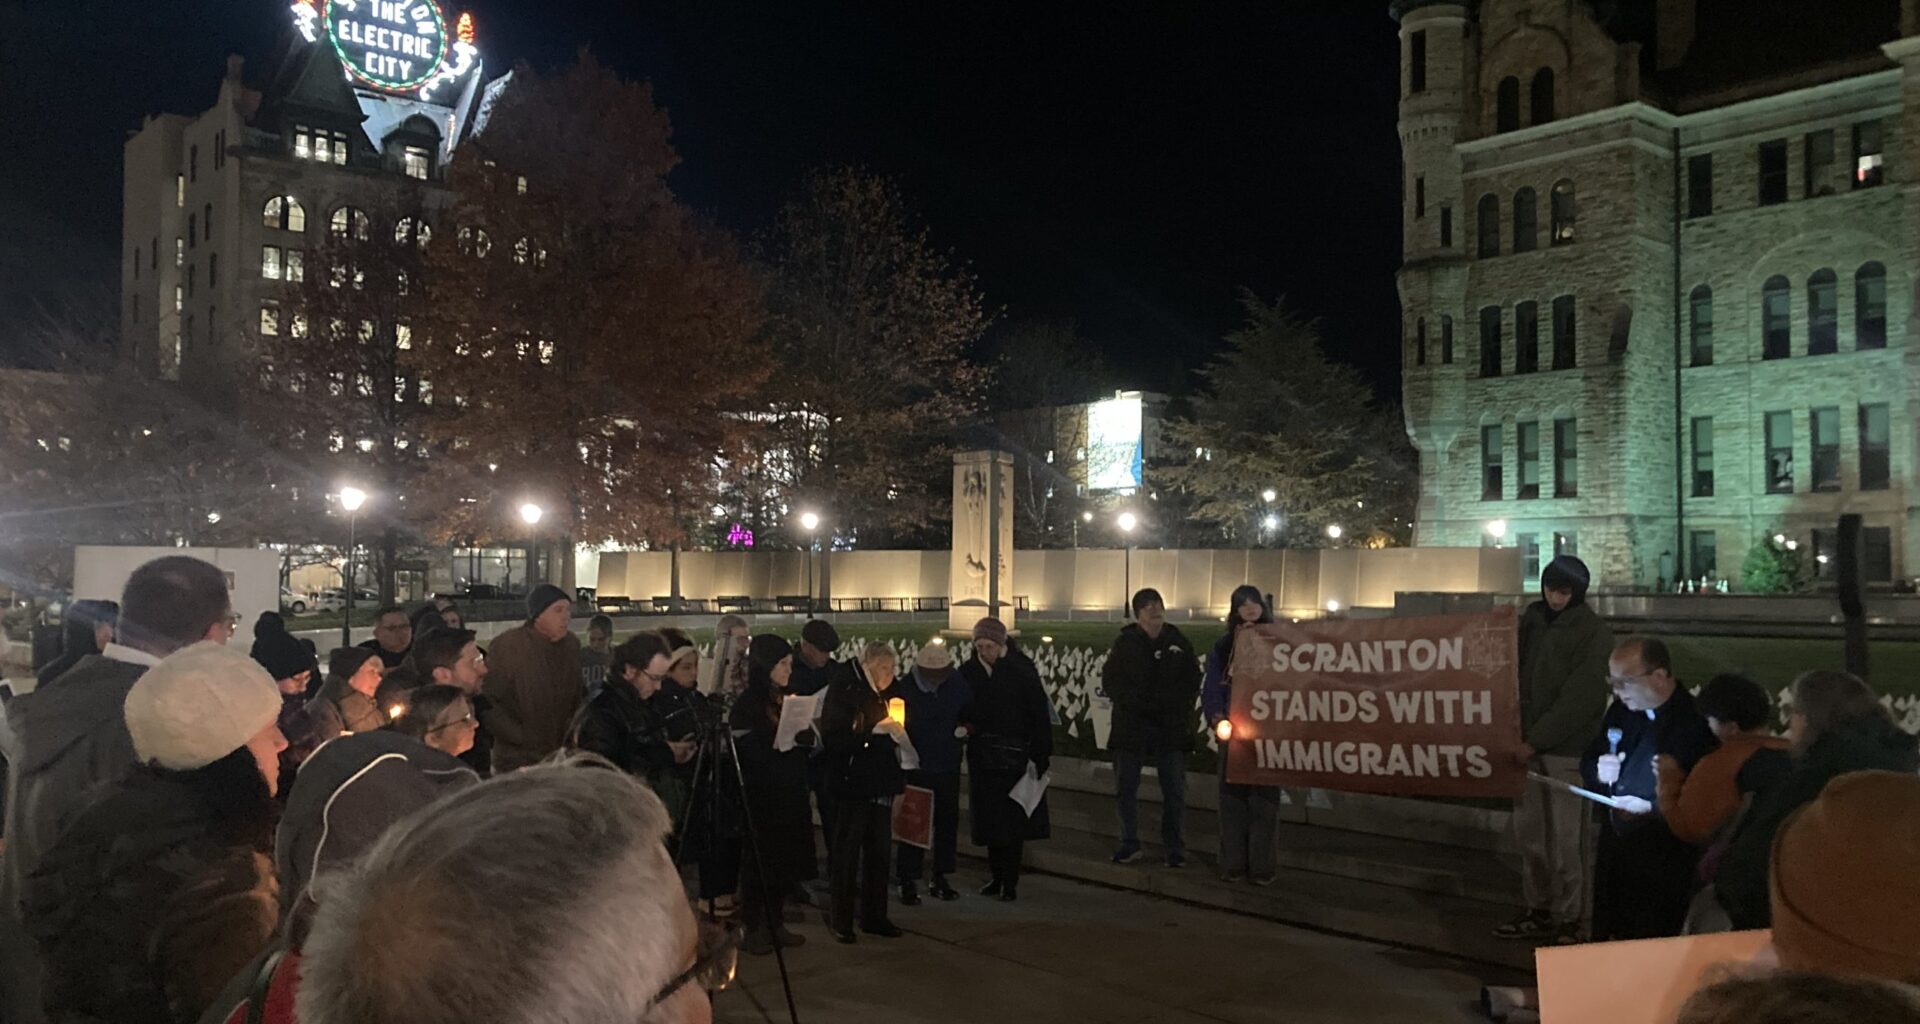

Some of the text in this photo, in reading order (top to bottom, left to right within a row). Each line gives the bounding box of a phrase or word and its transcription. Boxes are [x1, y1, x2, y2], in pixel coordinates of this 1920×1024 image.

[369, 0, 407, 24] THE
[338, 19, 433, 59] ELECTRIC
[365, 51, 412, 80] CITY
[1272, 636, 1464, 673] SCRANTON
[1251, 689, 1492, 725] STANDS WITH
[1255, 739, 1493, 779] IMMIGRANTS
